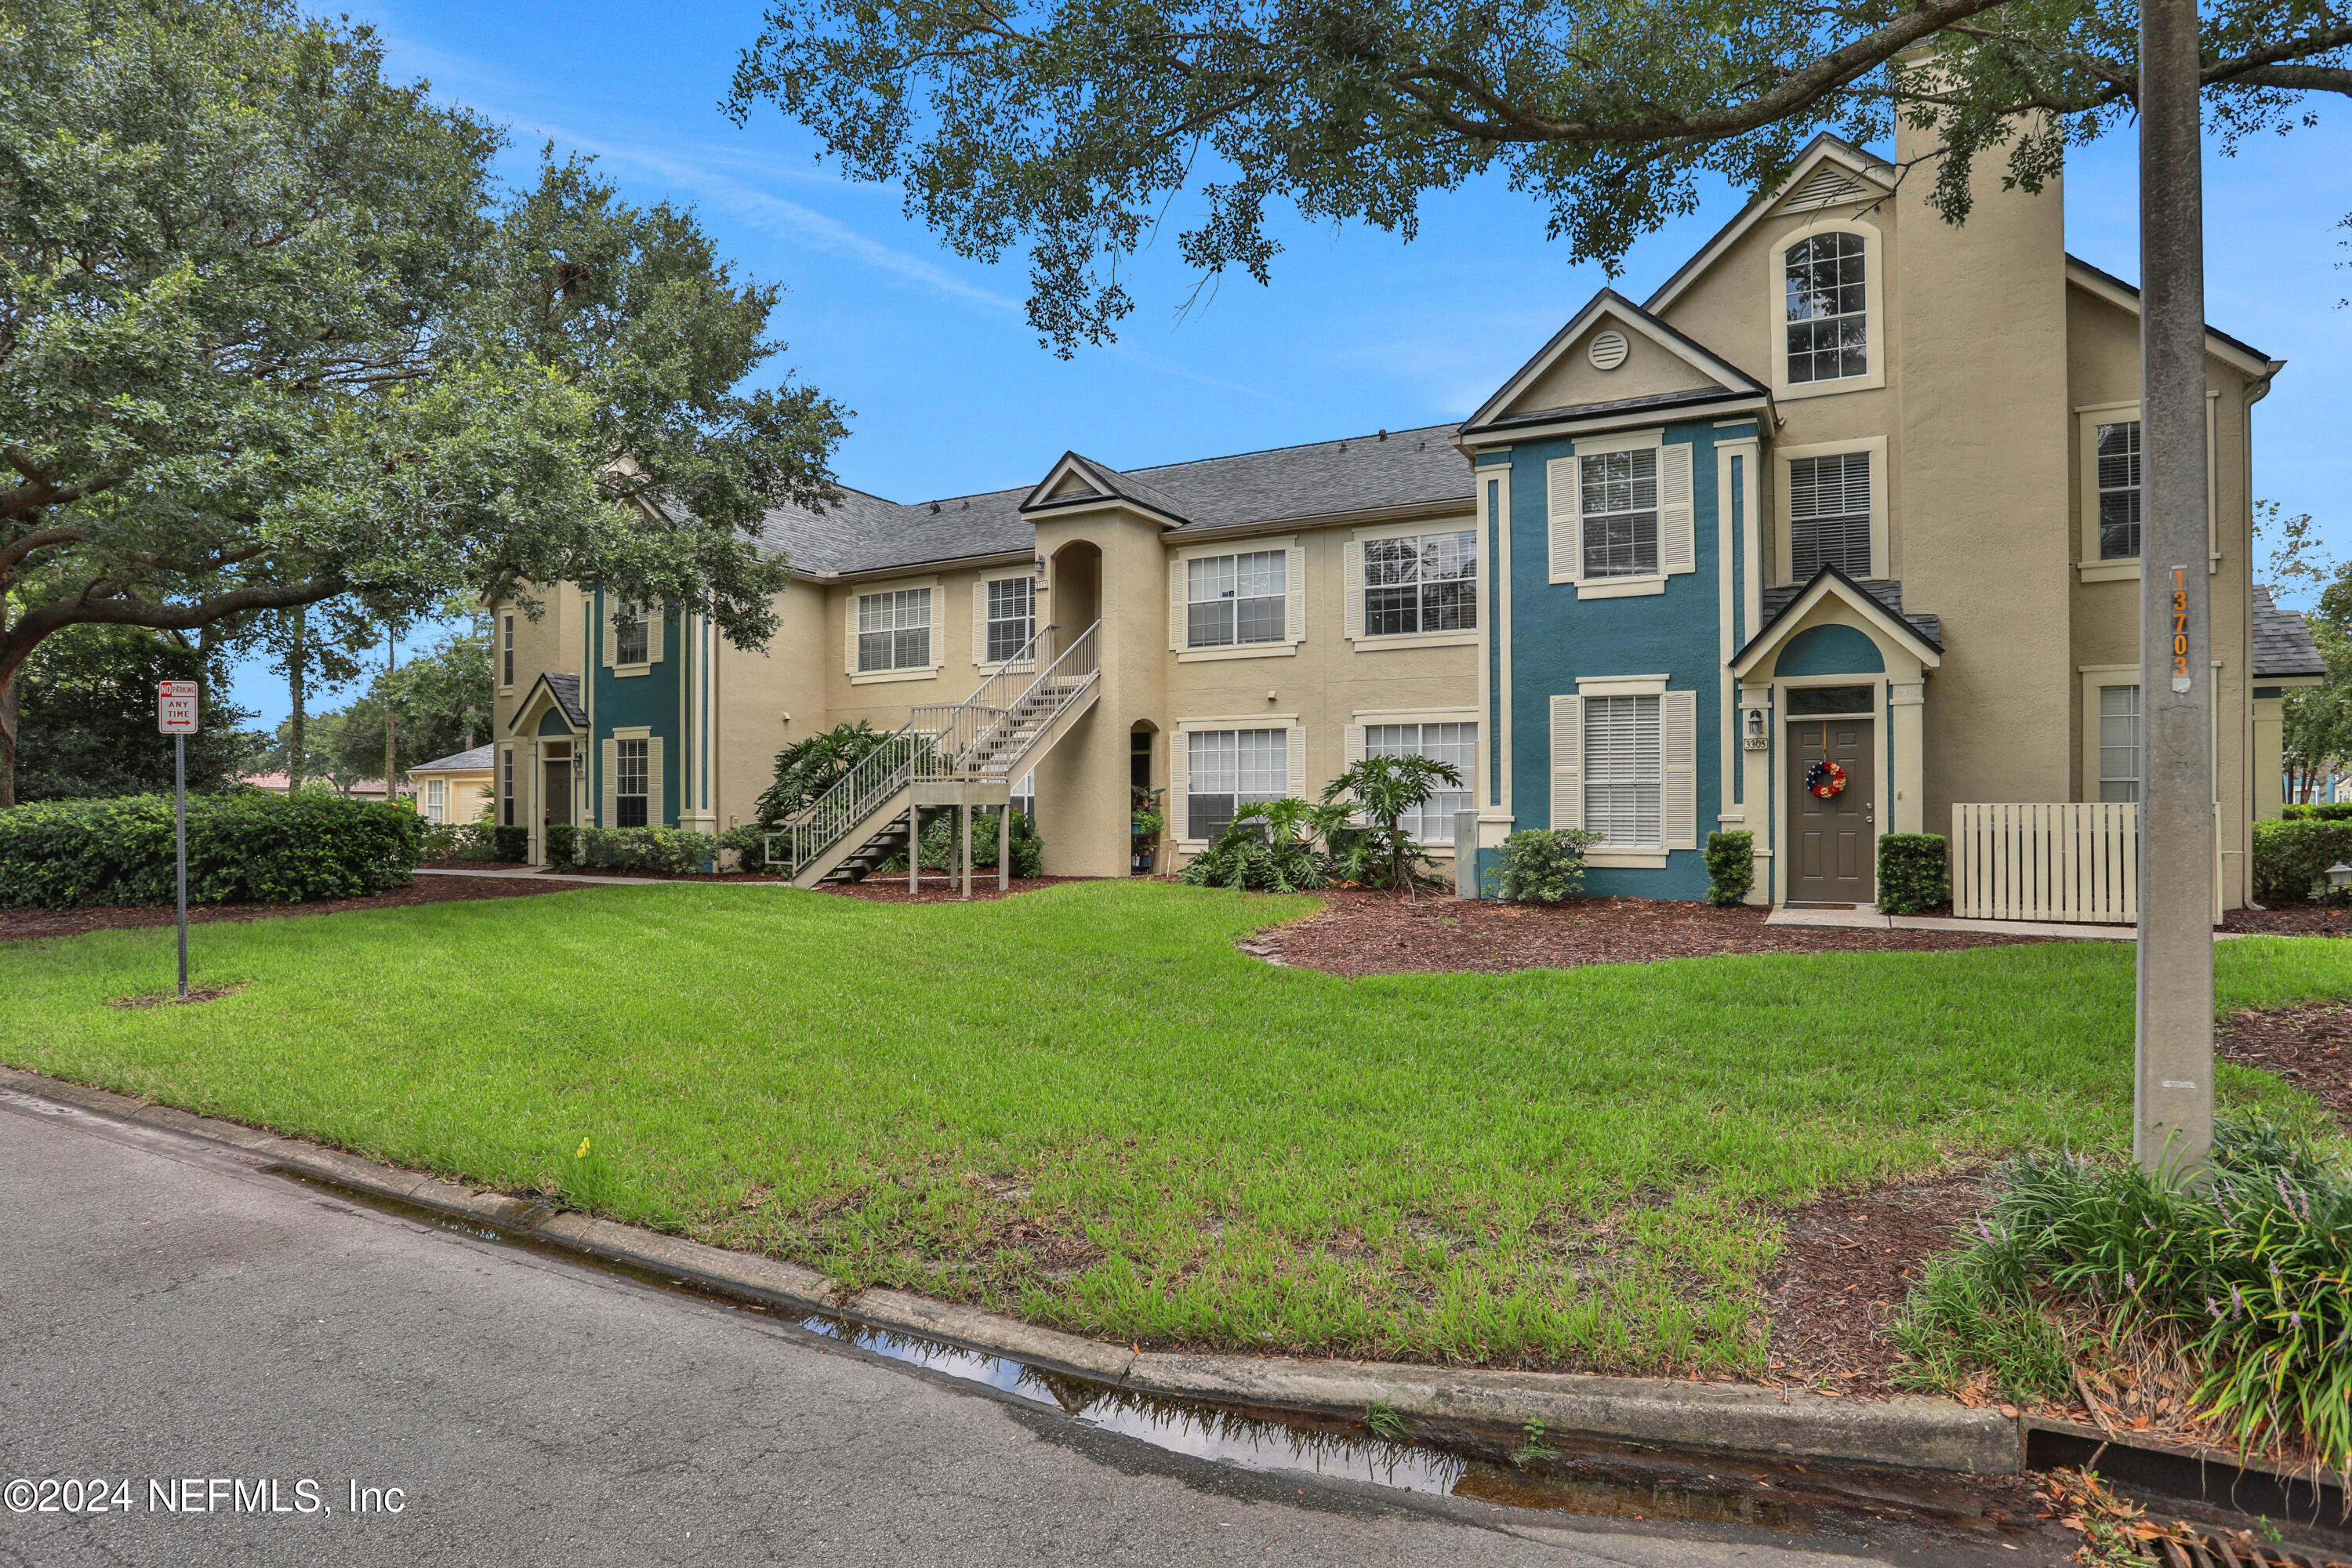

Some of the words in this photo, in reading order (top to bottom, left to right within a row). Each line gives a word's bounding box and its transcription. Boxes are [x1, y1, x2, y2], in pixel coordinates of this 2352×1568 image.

[2172, 569, 2187, 677] 13703
[161, 684, 172, 695] NO
[1745, 739, 1766, 749] 3305
